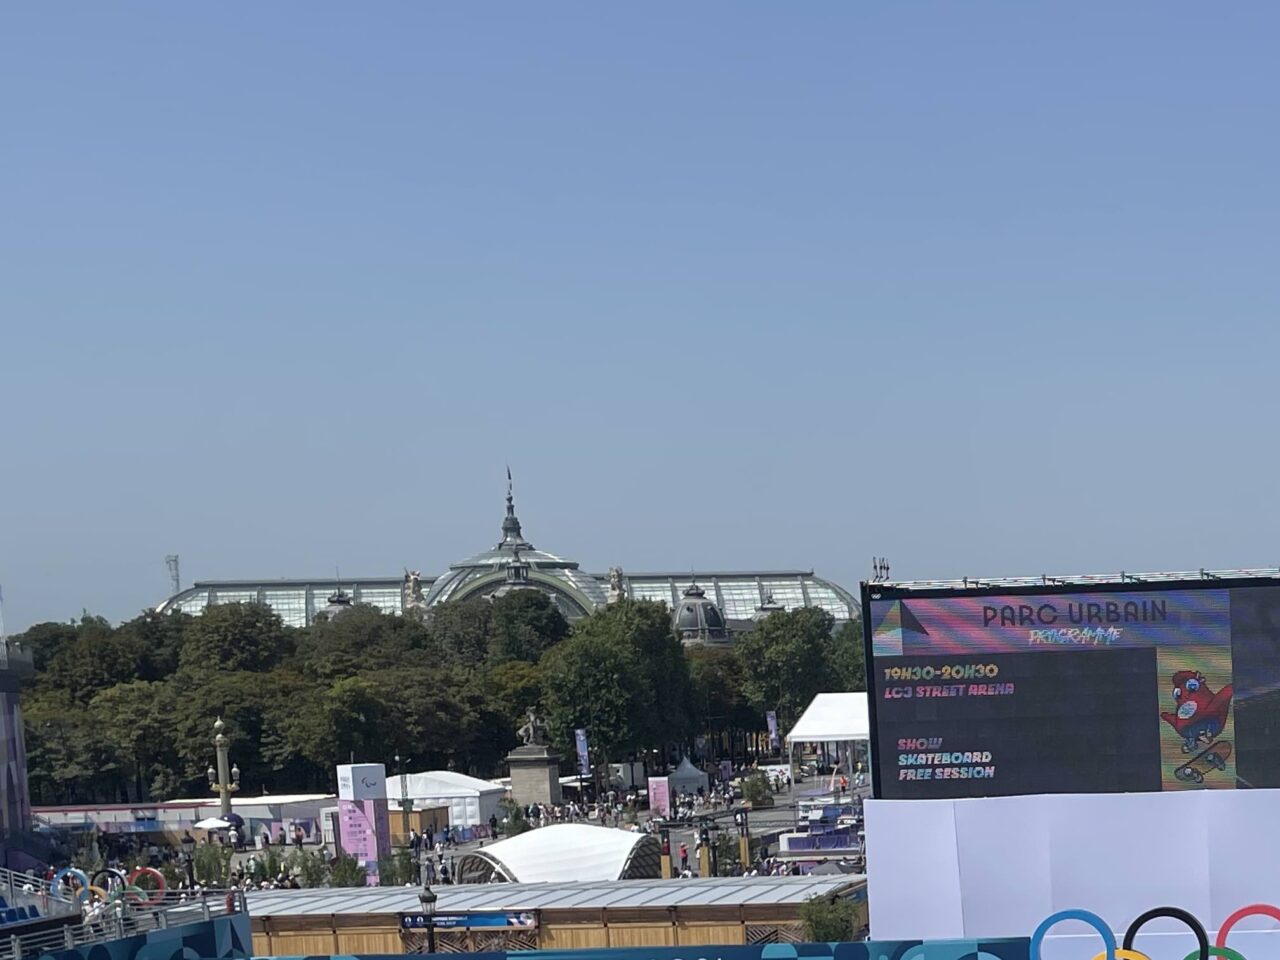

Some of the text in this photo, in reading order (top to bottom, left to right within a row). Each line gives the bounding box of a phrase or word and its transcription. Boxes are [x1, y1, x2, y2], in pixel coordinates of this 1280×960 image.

[982, 600, 1167, 628] PARC URBAIN
[884, 663, 999, 681] 19H30-20H30
[915, 684, 967, 698] STREET
[967, 682, 1015, 696] ARENA
[897, 737, 943, 750] SHOW
[898, 751, 992, 766] SKATEBOARD
[898, 765, 996, 781] FREE SESSION
